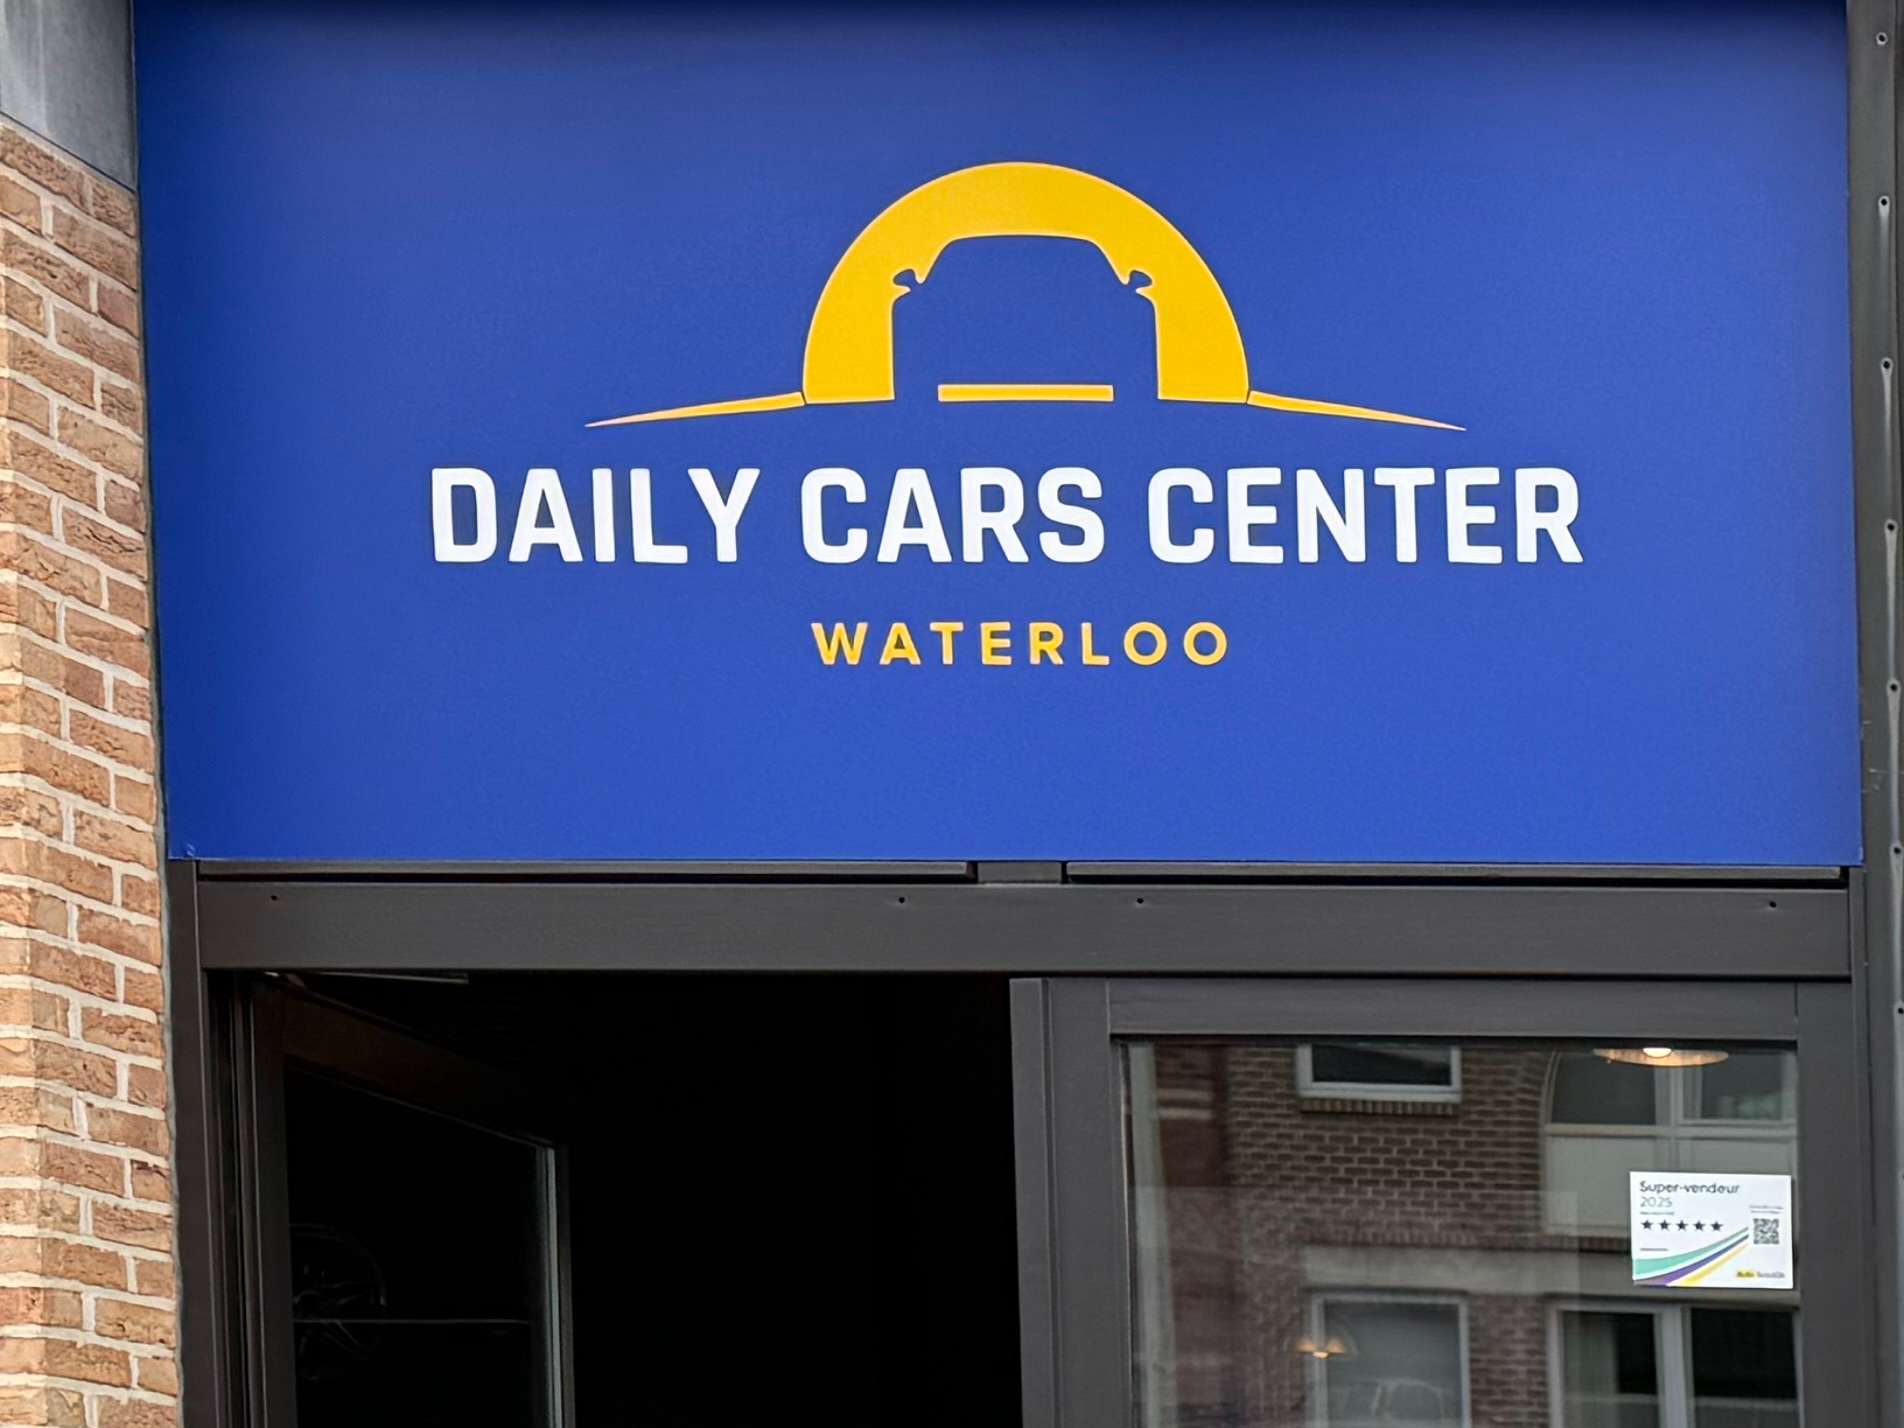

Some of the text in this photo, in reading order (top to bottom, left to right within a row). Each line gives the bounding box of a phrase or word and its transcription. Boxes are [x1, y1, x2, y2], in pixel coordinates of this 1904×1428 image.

[432, 468, 1583, 563] DAILY CARS CENTER
[811, 622, 1227, 665] WATERLOO
[1640, 1181, 1741, 1194] Super-vendeur
[1640, 1196, 1672, 1208] 2025
